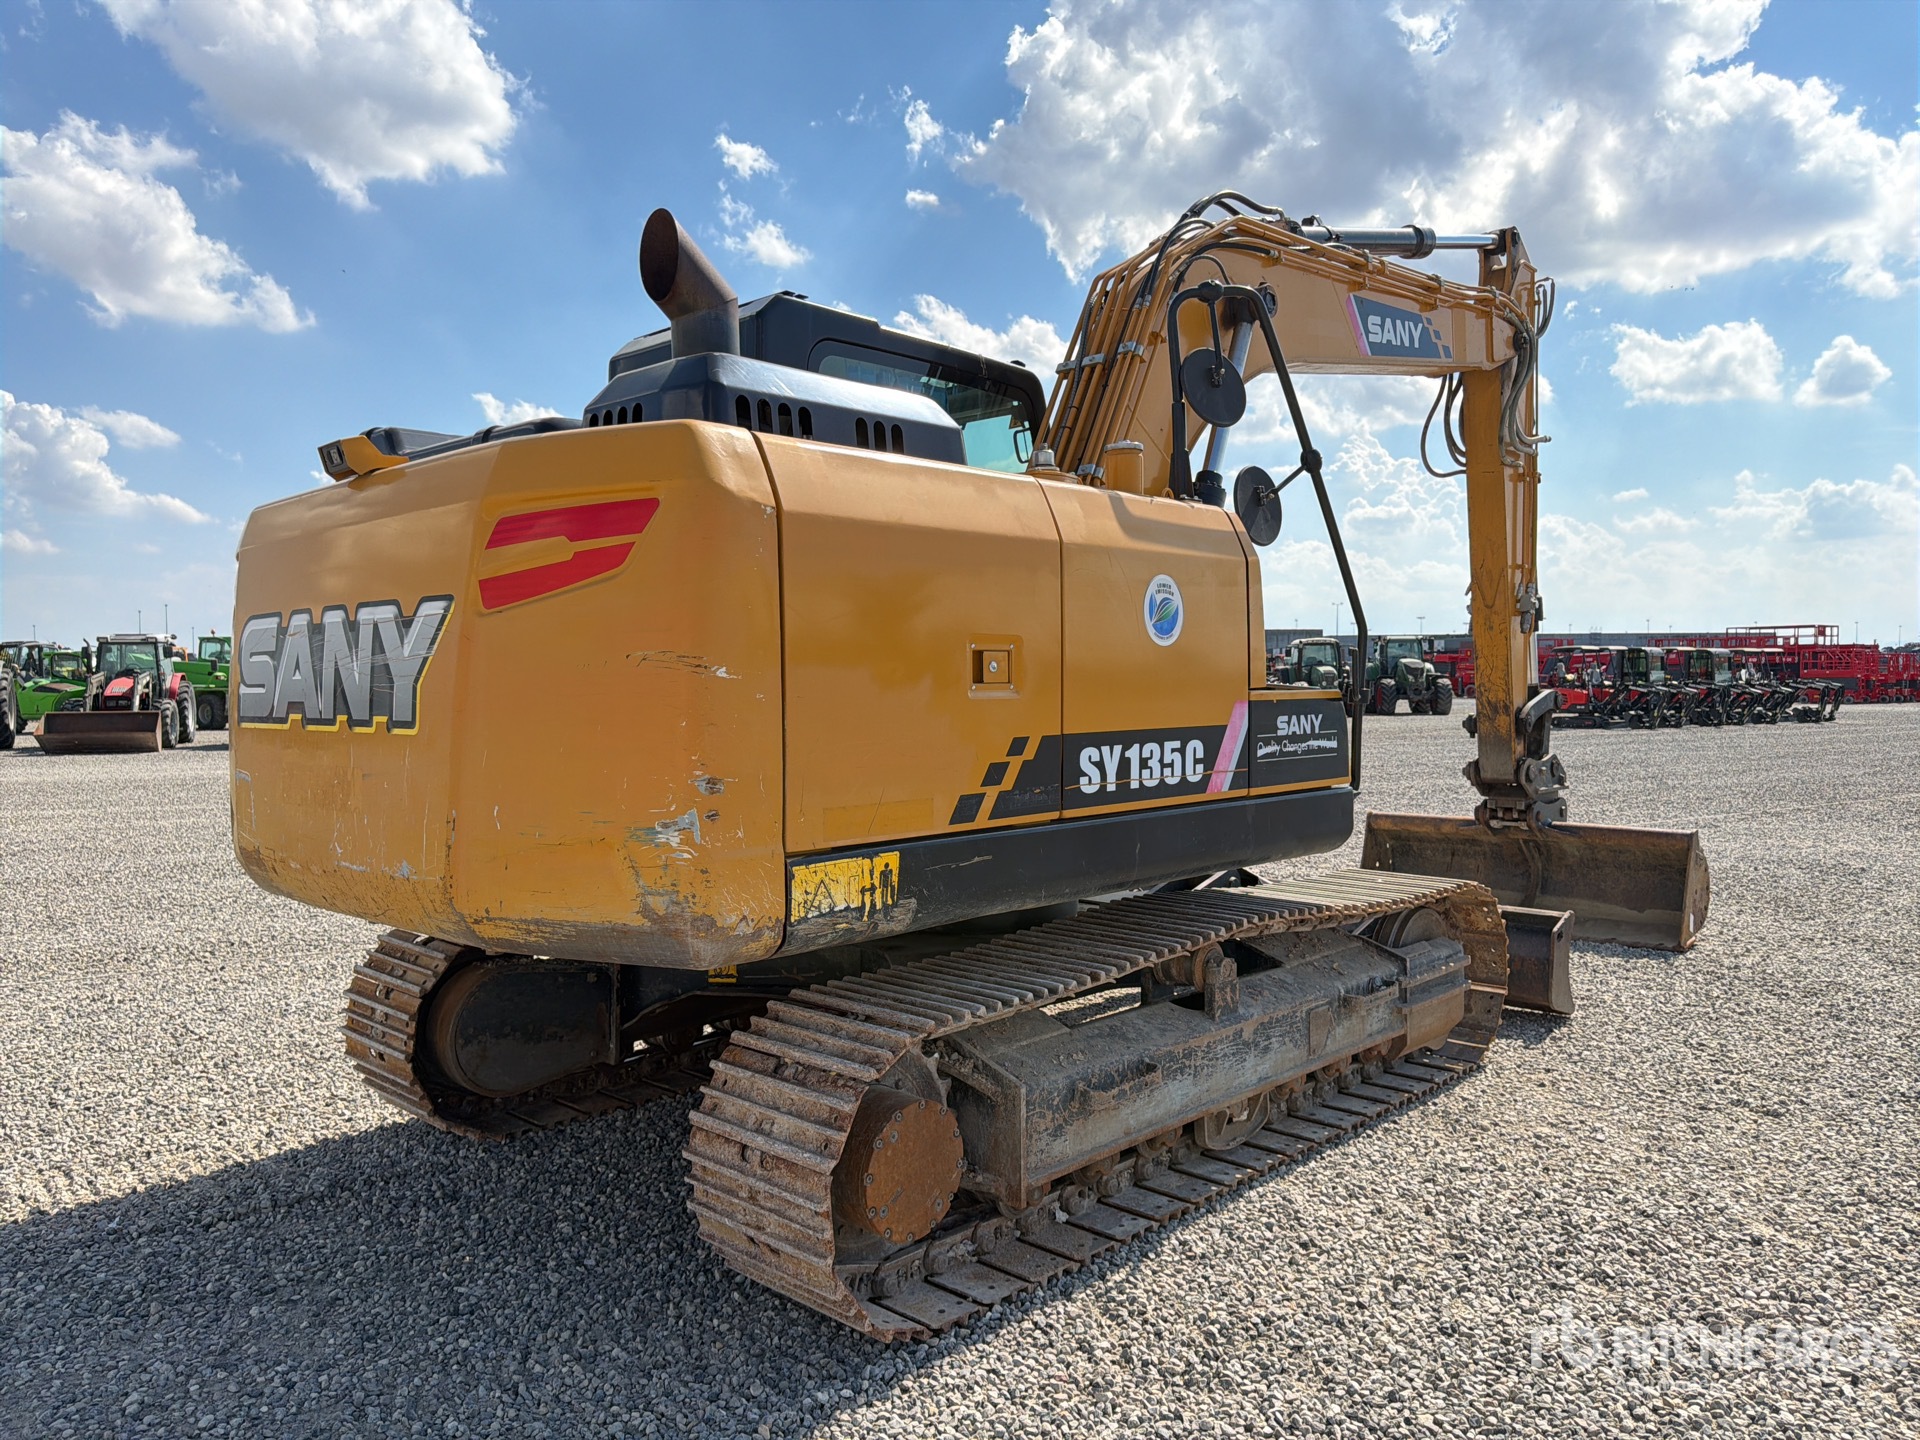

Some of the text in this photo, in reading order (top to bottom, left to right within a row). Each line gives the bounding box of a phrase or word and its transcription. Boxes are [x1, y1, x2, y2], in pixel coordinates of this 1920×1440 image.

[1367, 314, 1424, 349] SANY
[239, 596, 453, 728] SANY
[1276, 713, 1323, 736] SANY
[1281, 739, 1308, 754] Changes
[1079, 739, 1205, 794] SY135C
